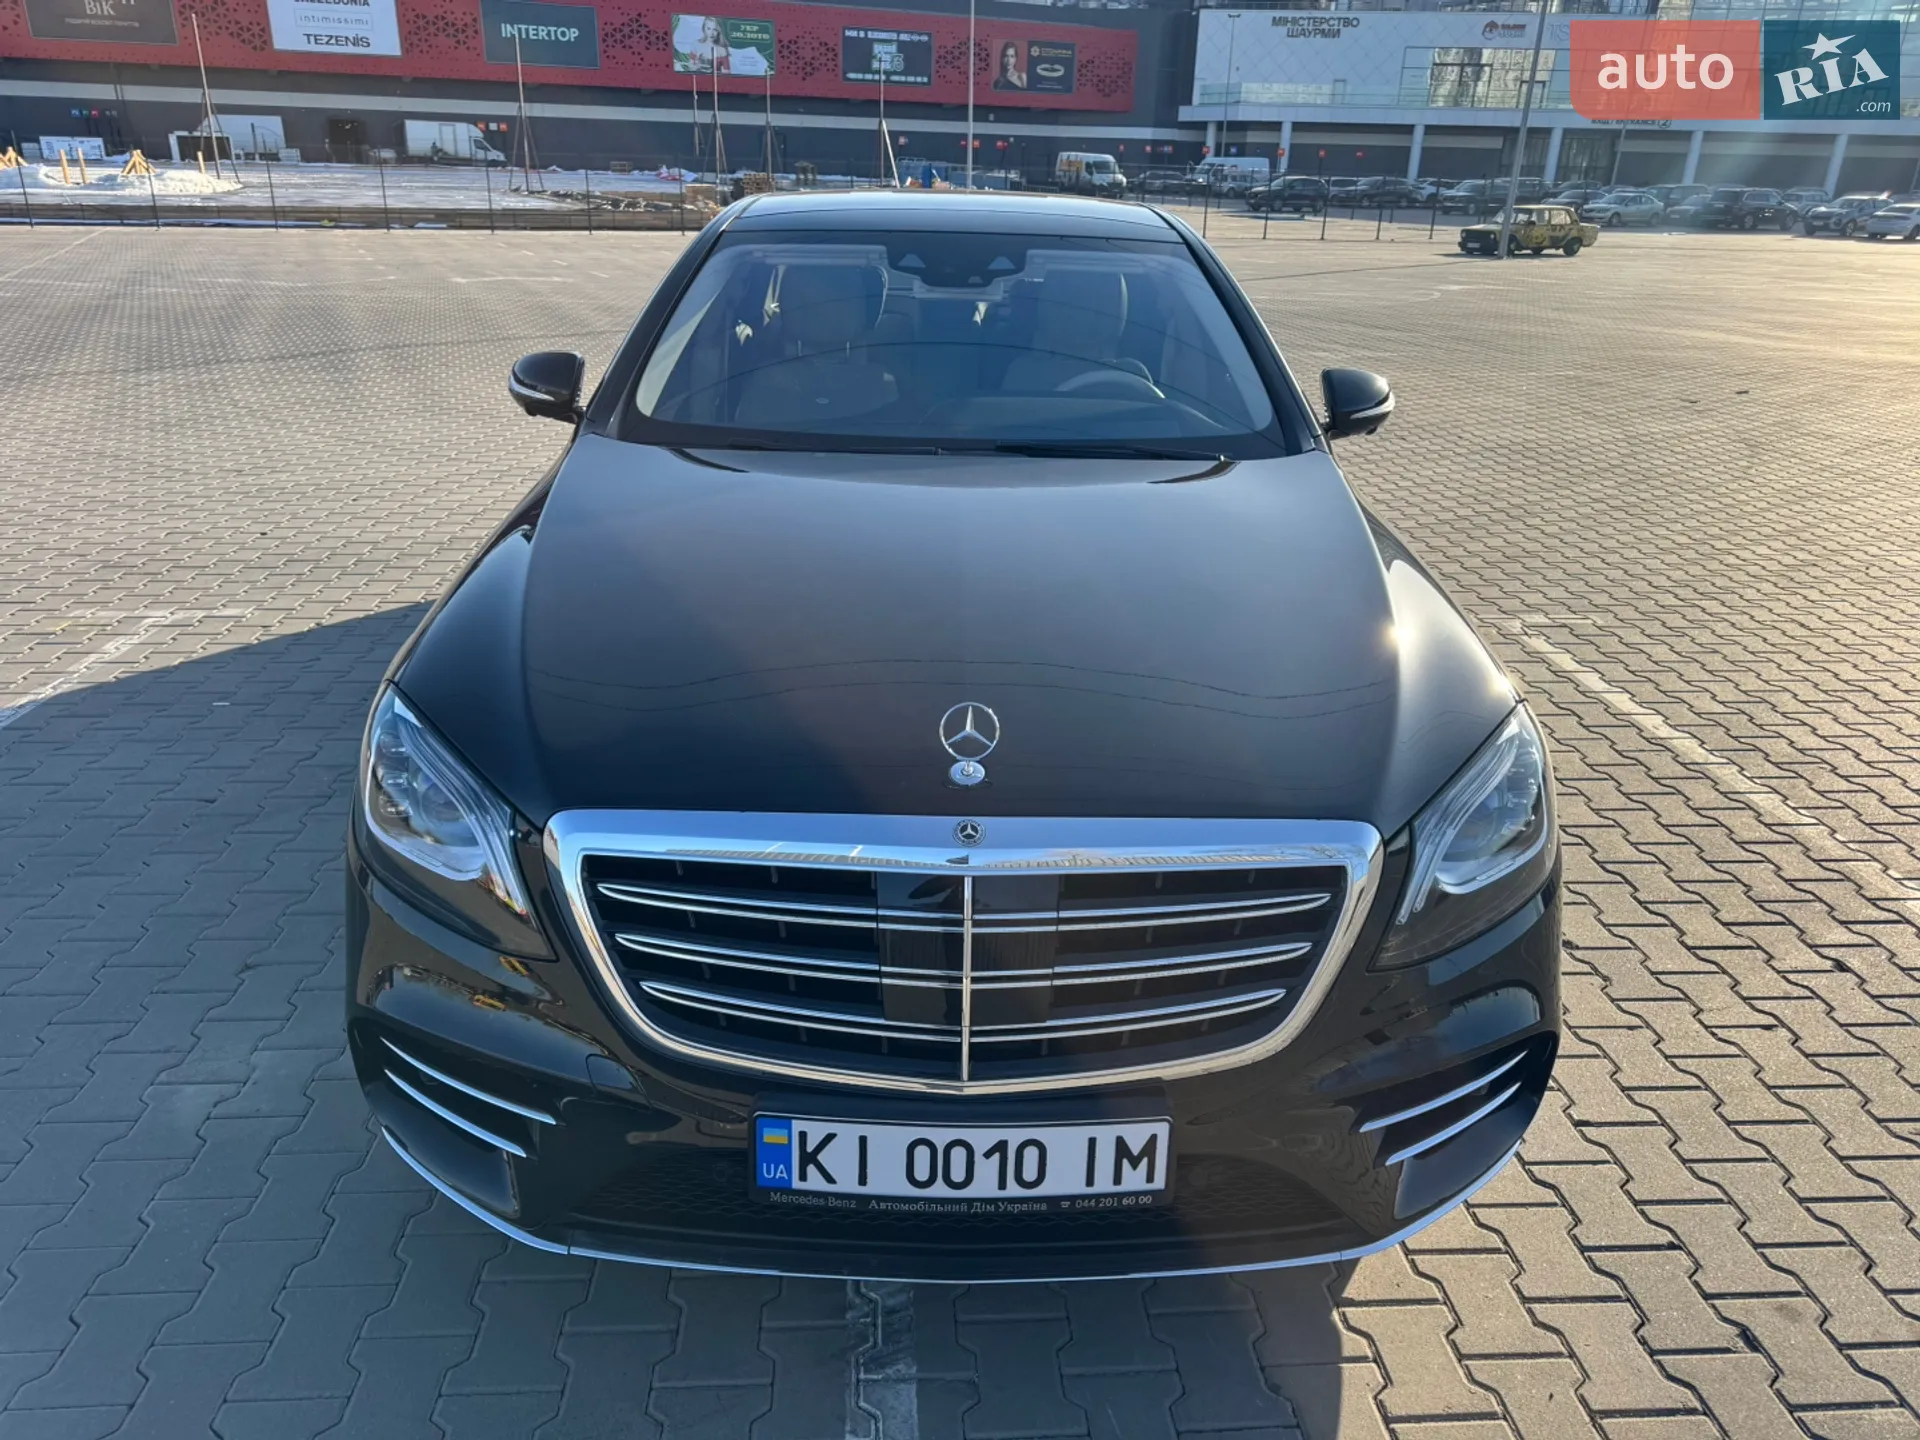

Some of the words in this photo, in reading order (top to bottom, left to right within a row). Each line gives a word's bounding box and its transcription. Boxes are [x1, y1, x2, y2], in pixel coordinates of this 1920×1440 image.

[299, 14, 369, 26] intimissimi
[1271, 16, 1360, 28] МІНІСТЕРСТВО
[501, 23, 579, 42] INTERTOP
[1286, 27, 1341, 39] ШАУРМИ
[798, 1131, 868, 1187] KI
[906, 1137, 1048, 1190] 0010
[1085, 1133, 1158, 1188] IM
[763, 1163, 788, 1180] UA
[868, 1199, 968, 1212] Автомобільний
[971, 1202, 995, 1213] Дім
[998, 1201, 1047, 1213] Україна
[1075, 1199, 1096, 1208] 044
[1099, 1197, 1118, 1207] 201
[1122, 1196, 1136, 1206] 60
[1138, 1195, 1152, 1204] 00
